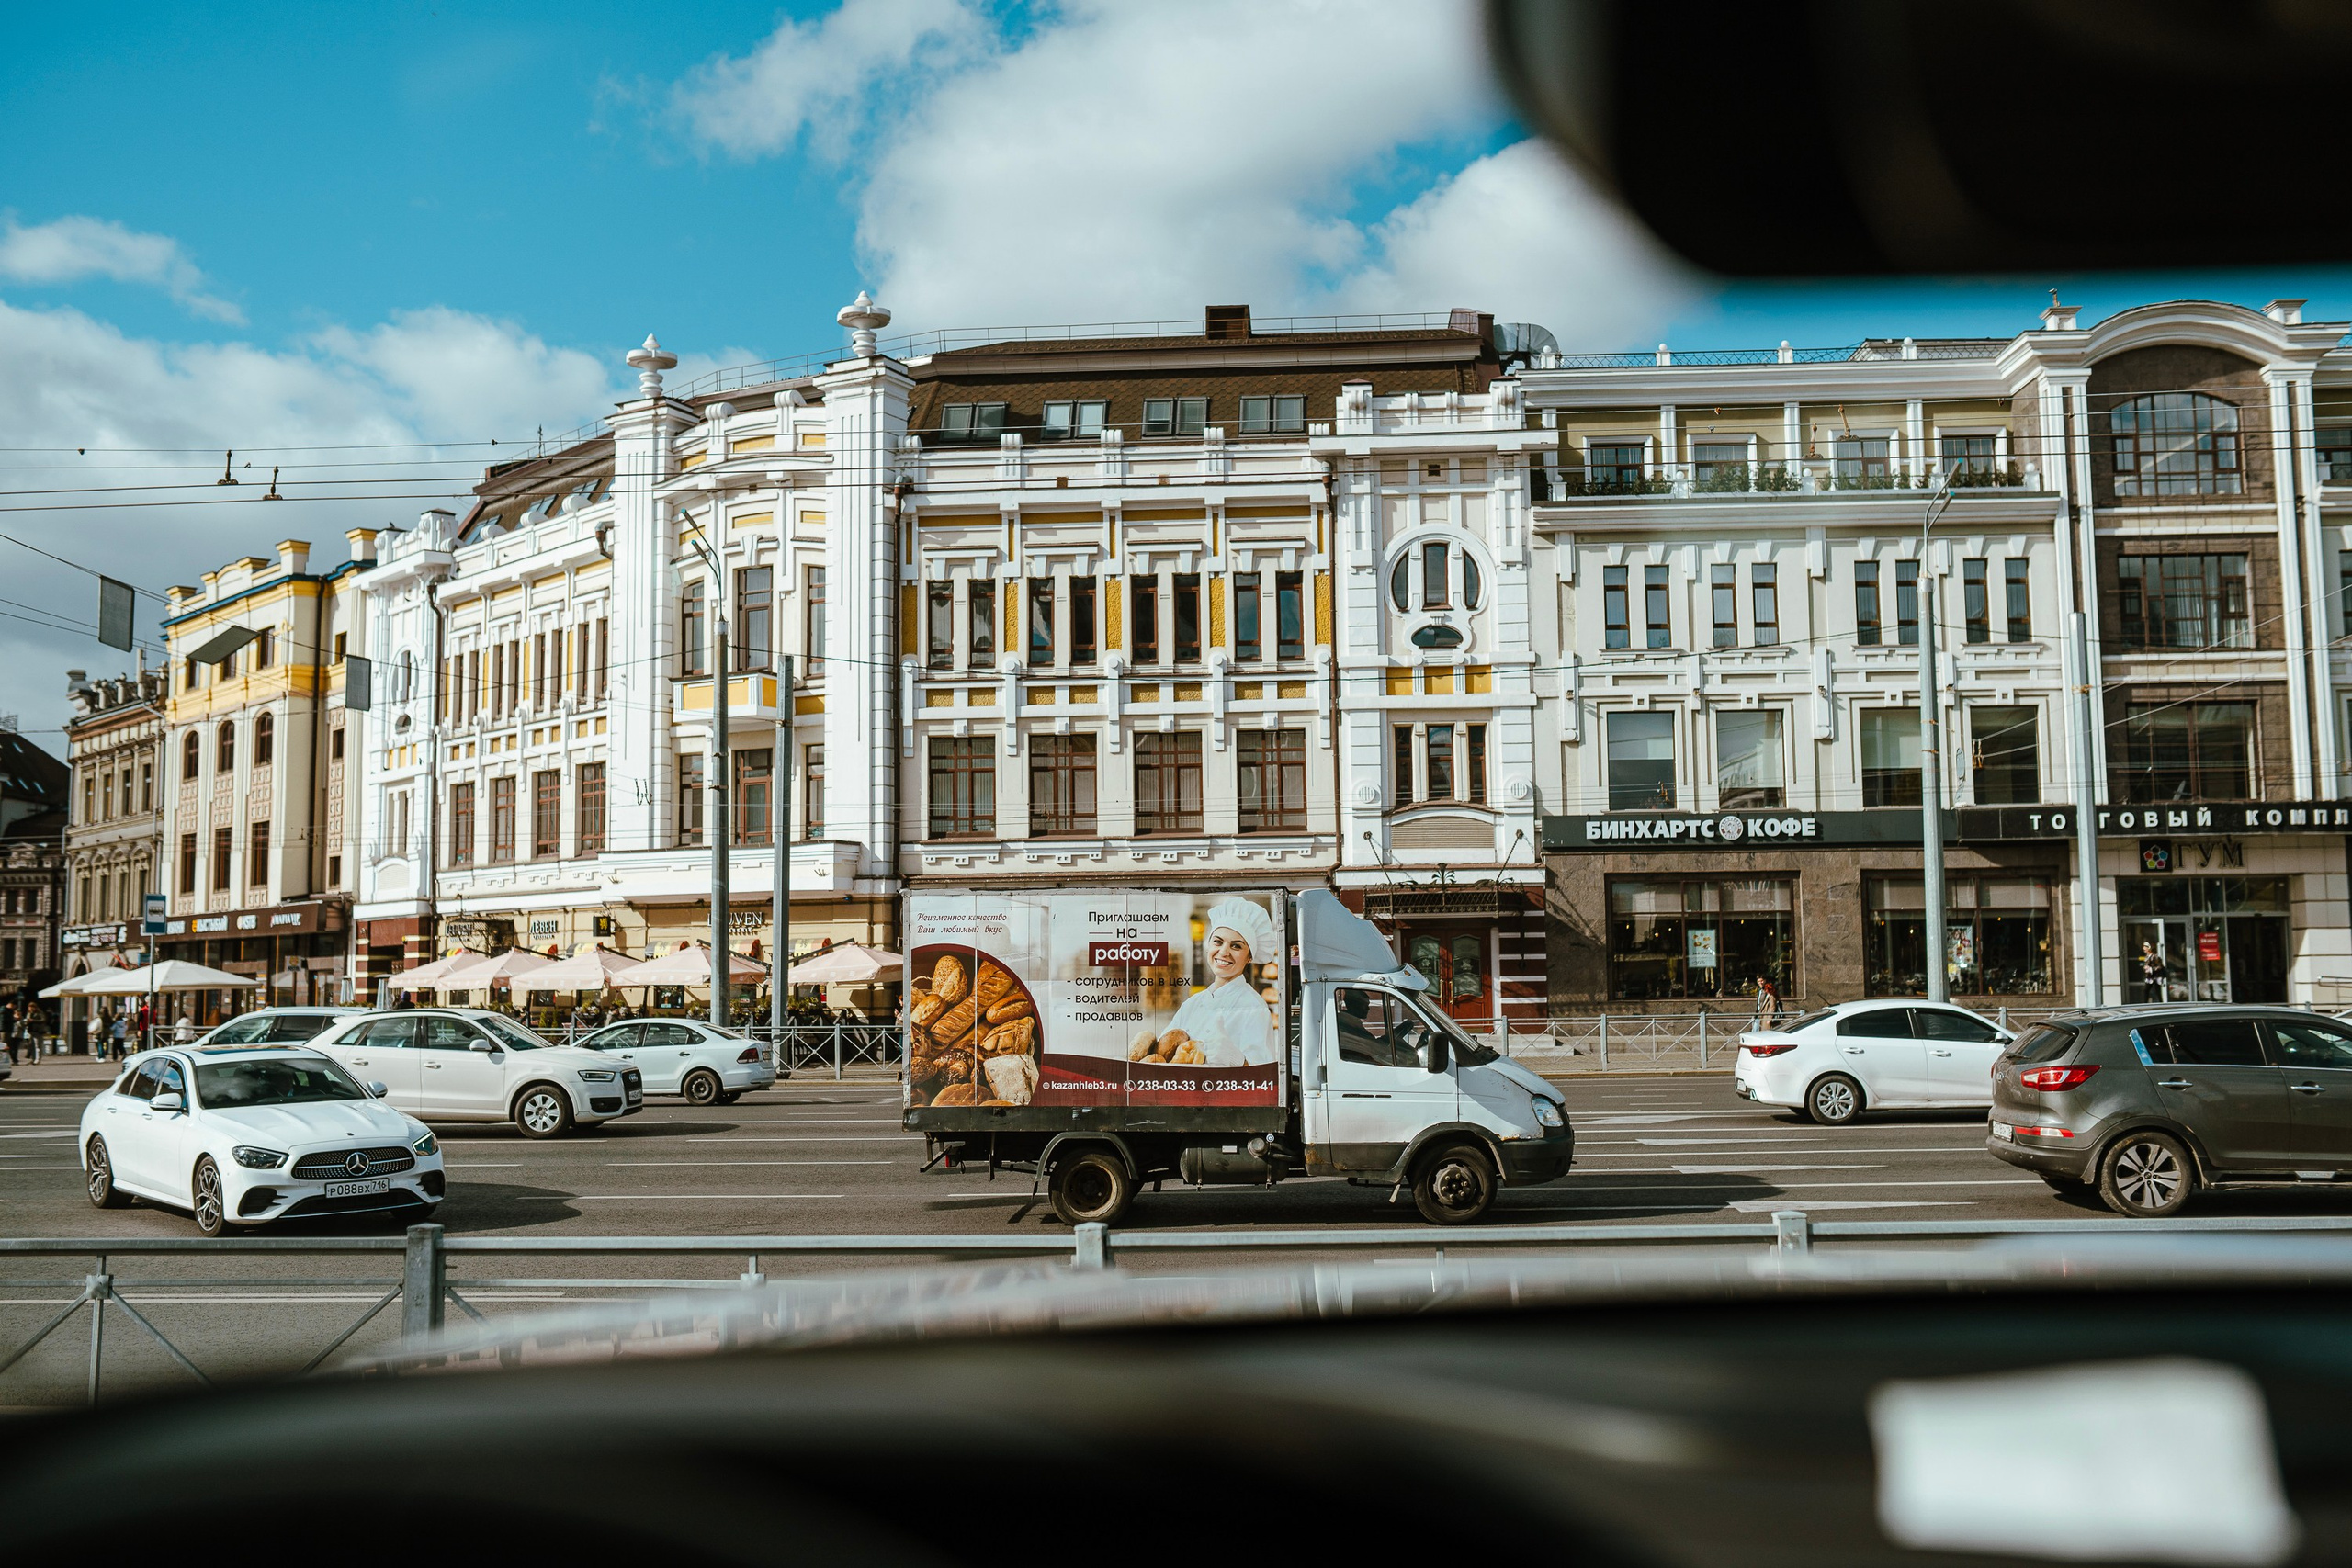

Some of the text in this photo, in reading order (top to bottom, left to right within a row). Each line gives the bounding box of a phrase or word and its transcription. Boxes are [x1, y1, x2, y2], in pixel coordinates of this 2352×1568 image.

[2030, 807, 2211, 830] ТОГОВЫЙ
[1586, 819, 1714, 840] БИНХАРТС
[1747, 817, 1816, 838] КОФЕ
[2174, 841, 2245, 869] ГУМ
[707, 912, 763, 926] LUVEN
[917, 912, 1008, 921] Неизменное качество
[1088, 911, 1169, 925] Приглашаем
[918, 925, 1003, 935] Ваш любимый вкус
[1116, 928, 1138, 938] на
[1095, 943, 1159, 964] работу
[1075, 977, 1154, 988] сотрудников
[1159, 977, 1165, 986] в
[1169, 977, 1191, 987] цех
[1075, 993, 1139, 1004] водителей
[1075, 1012, 1143, 1023] продавцов
[1051, 1080, 1274, 1091] kazanhleb3.ru 238-03-33 238-31-41
